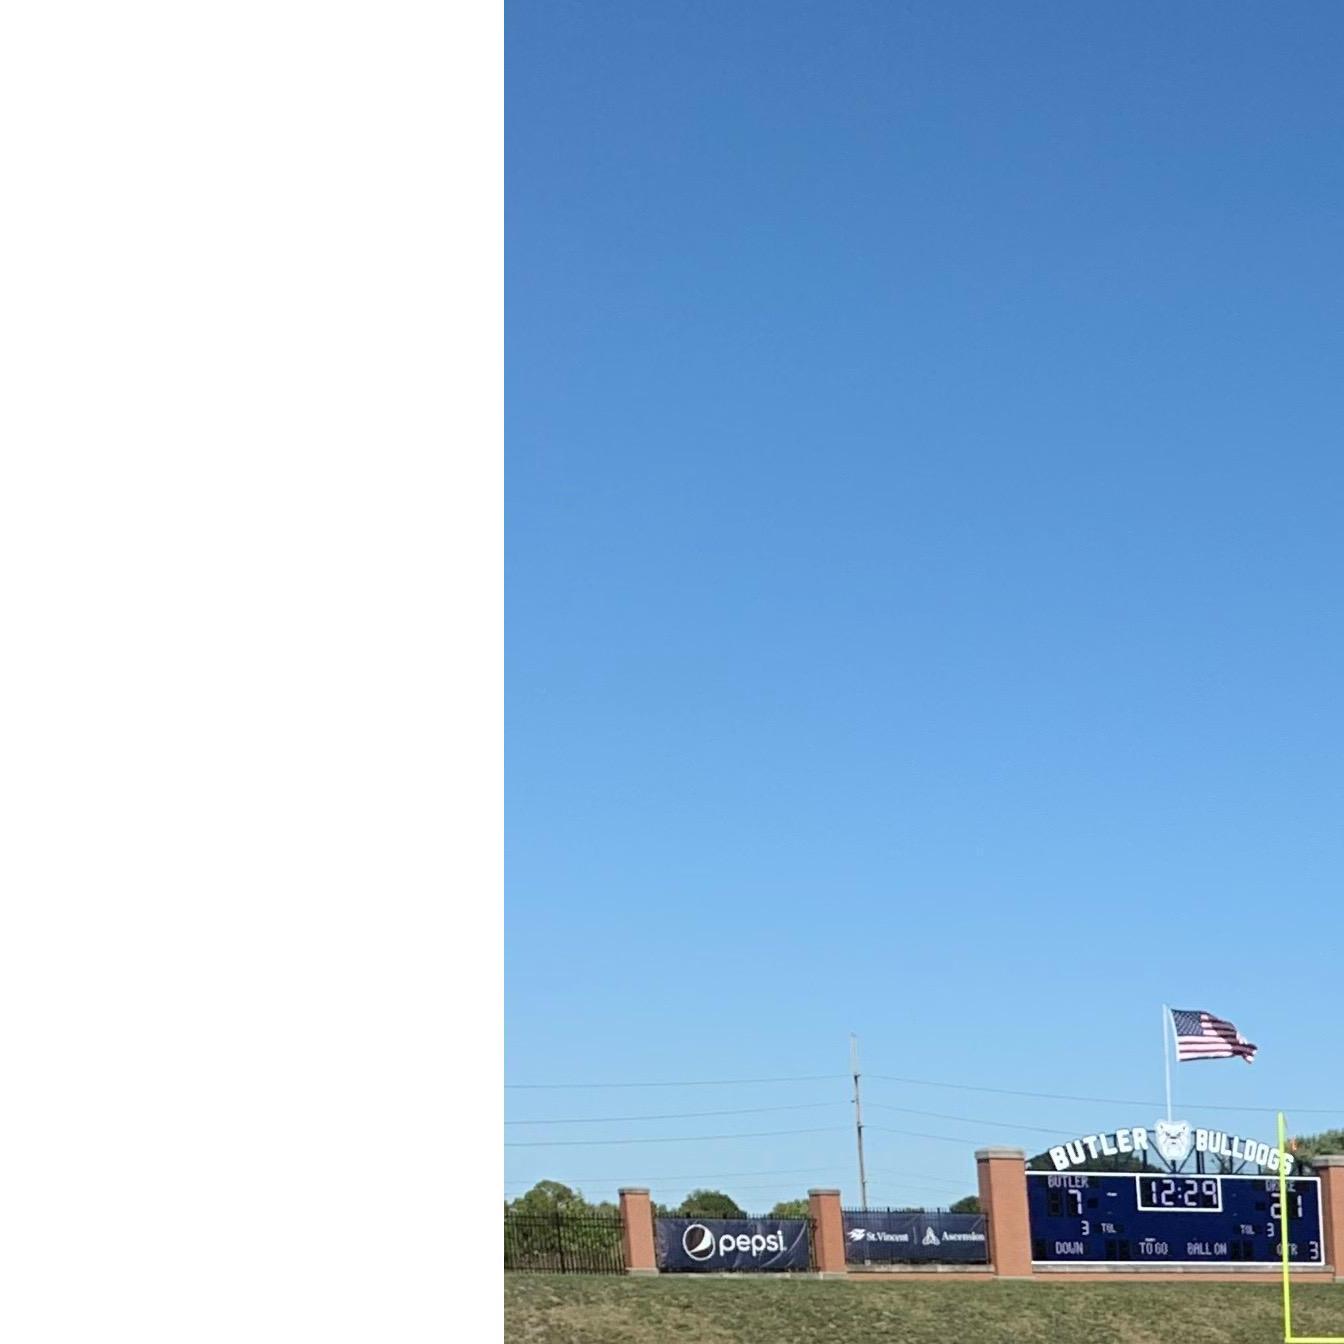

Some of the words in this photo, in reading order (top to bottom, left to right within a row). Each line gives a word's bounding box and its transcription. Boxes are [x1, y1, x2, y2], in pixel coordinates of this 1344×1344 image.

[1049, 1127, 1149, 1171] BUTLER
[1195, 1128, 1294, 1175] BULLDOGS
[1047, 1175, 1089, 1188] BUTLER
[1151, 1180, 1217, 1206] 12:29
[1068, 1189, 1082, 1214] 7
[1081, 1220, 1090, 1236] 3
[1266, 1222, 1275, 1238] 3
[719, 1230, 784, 1257] pepsi
[941, 1231, 985, 1242] Ascension
[1055, 1241, 1084, 1255] DOWN
[1139, 1242, 1153, 1255] TO
[1155, 1242, 1169, 1255] GO
[1187, 1242, 1212, 1256] BALL
[1214, 1242, 1228, 1255] ON
[1309, 1240, 1319, 1259] 3
